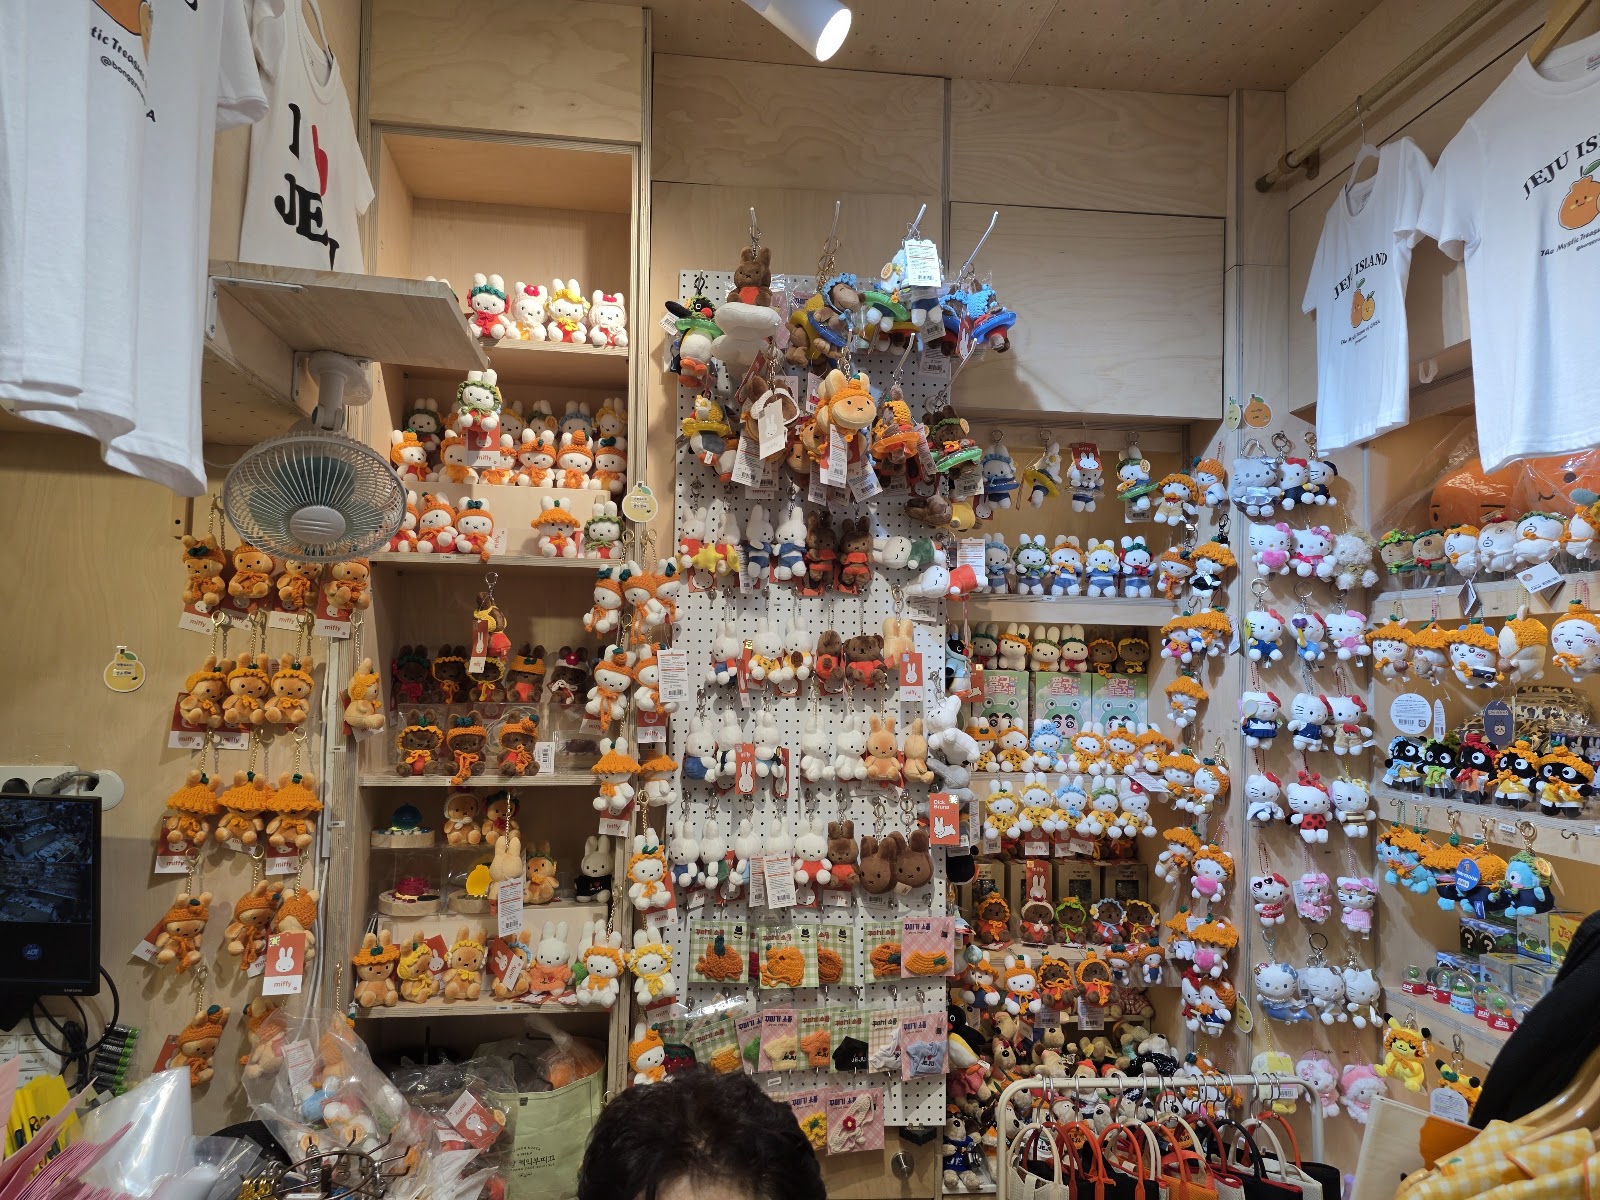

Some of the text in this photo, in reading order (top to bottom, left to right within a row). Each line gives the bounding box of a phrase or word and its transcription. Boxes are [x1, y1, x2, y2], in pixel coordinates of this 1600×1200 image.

[1523, 151, 1569, 200] JEJU
[1355, 252, 1388, 275] ISLAND
[190, 618, 206, 627] miffy
[279, 616, 296, 624] miffy
[324, 624, 341, 632] miffy
[222, 736, 240, 744] miffy
[606, 823, 620, 831] miffy
[655, 914, 669, 922] miffy
[509, 964, 517, 980] miffy
[655, 1010, 671, 1018] miffy
